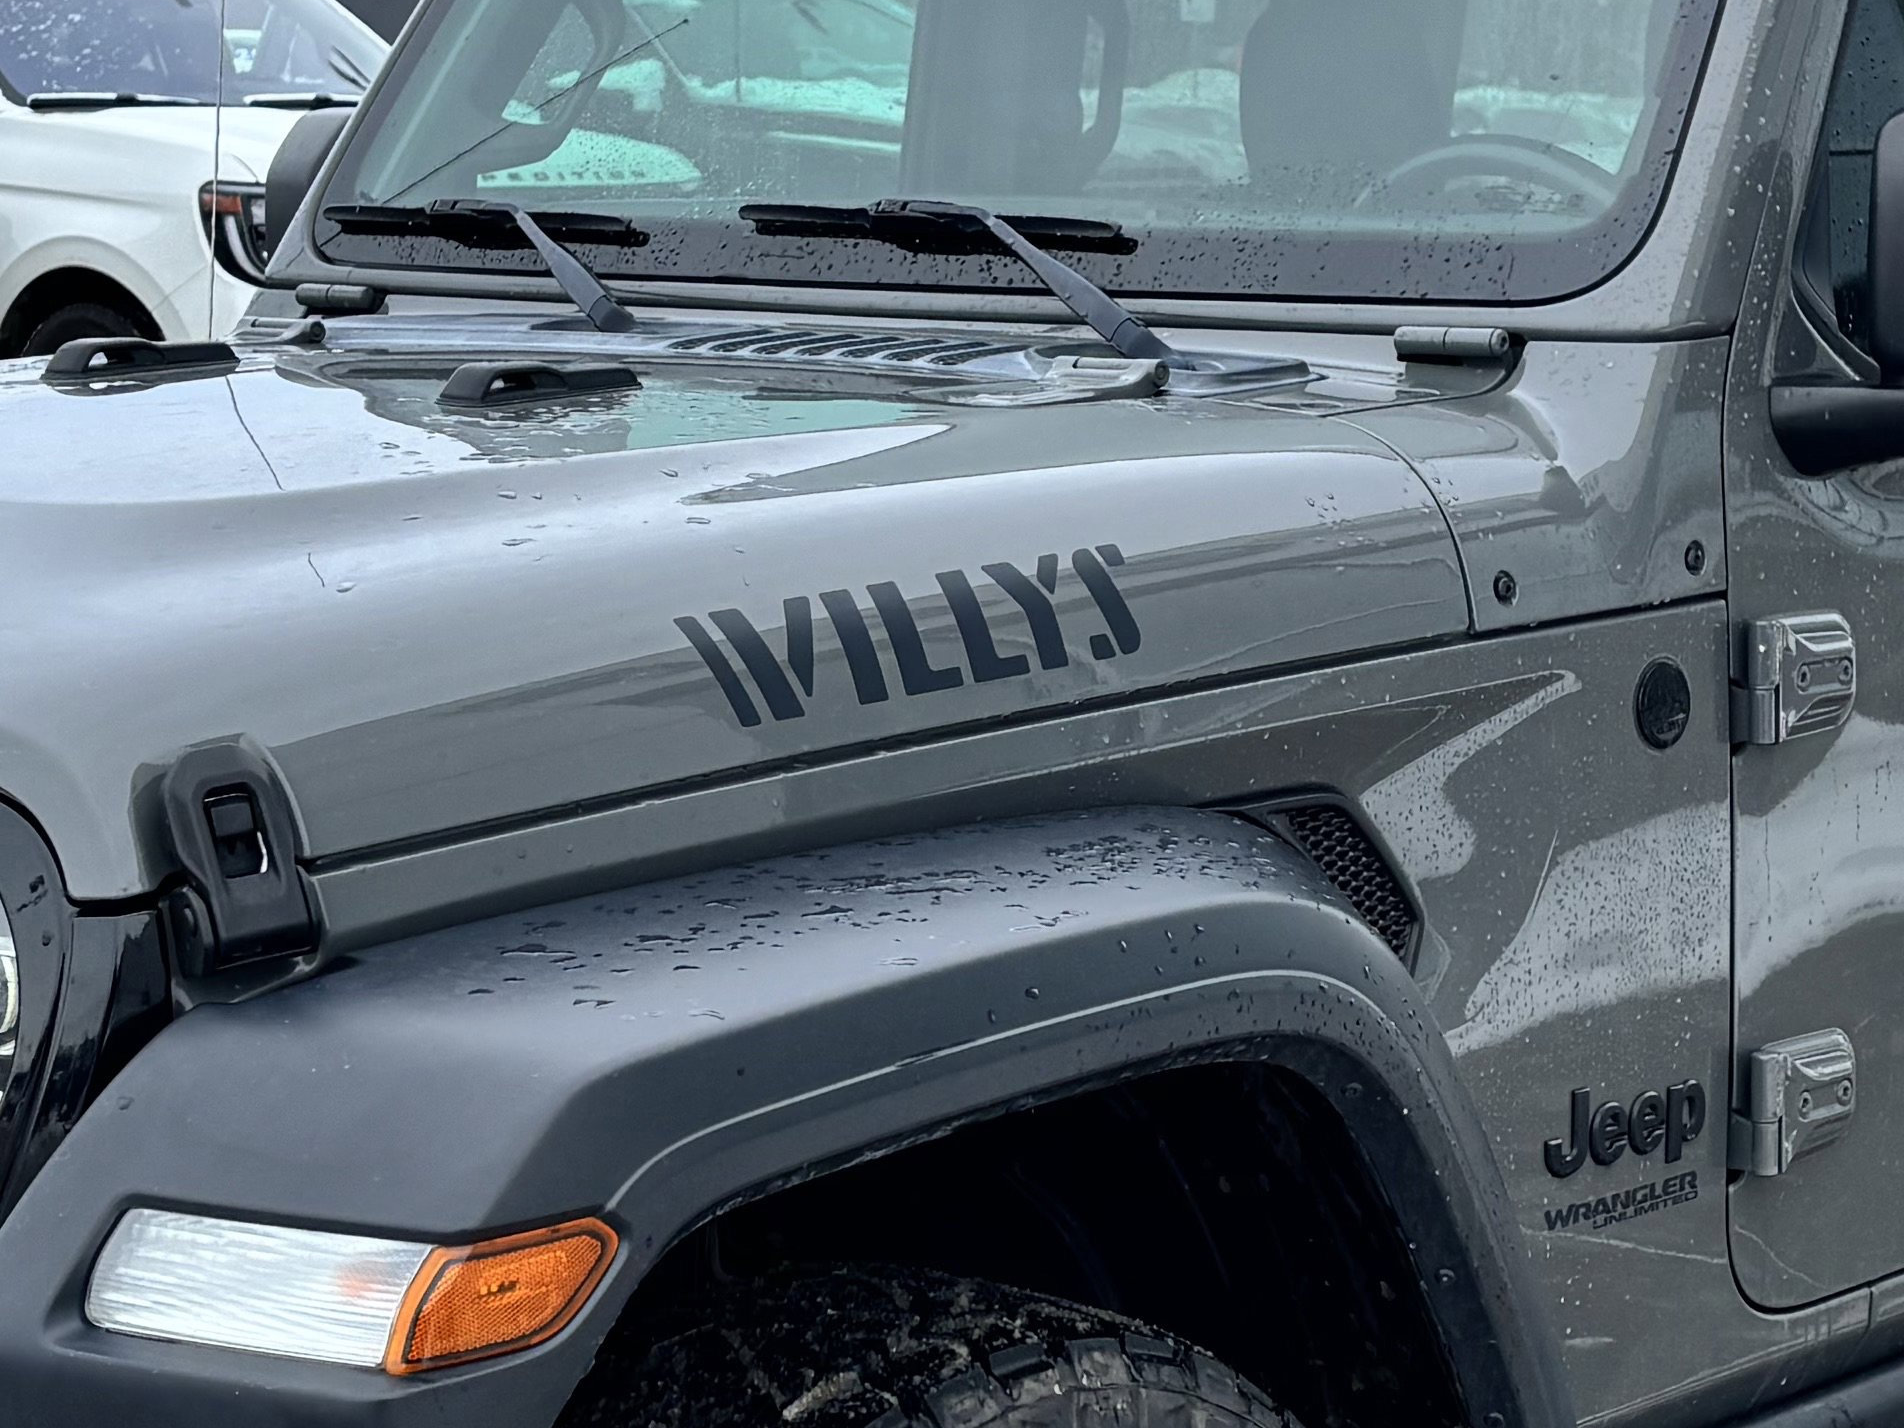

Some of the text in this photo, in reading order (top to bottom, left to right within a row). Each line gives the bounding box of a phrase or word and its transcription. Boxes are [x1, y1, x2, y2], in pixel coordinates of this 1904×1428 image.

[673, 543, 1142, 728] WILLYS
[1543, 1078, 1706, 1179] Jeep
[1544, 1171, 1699, 1231] WRANGLER
[1592, 1189, 1699, 1230] UNLIMITED
